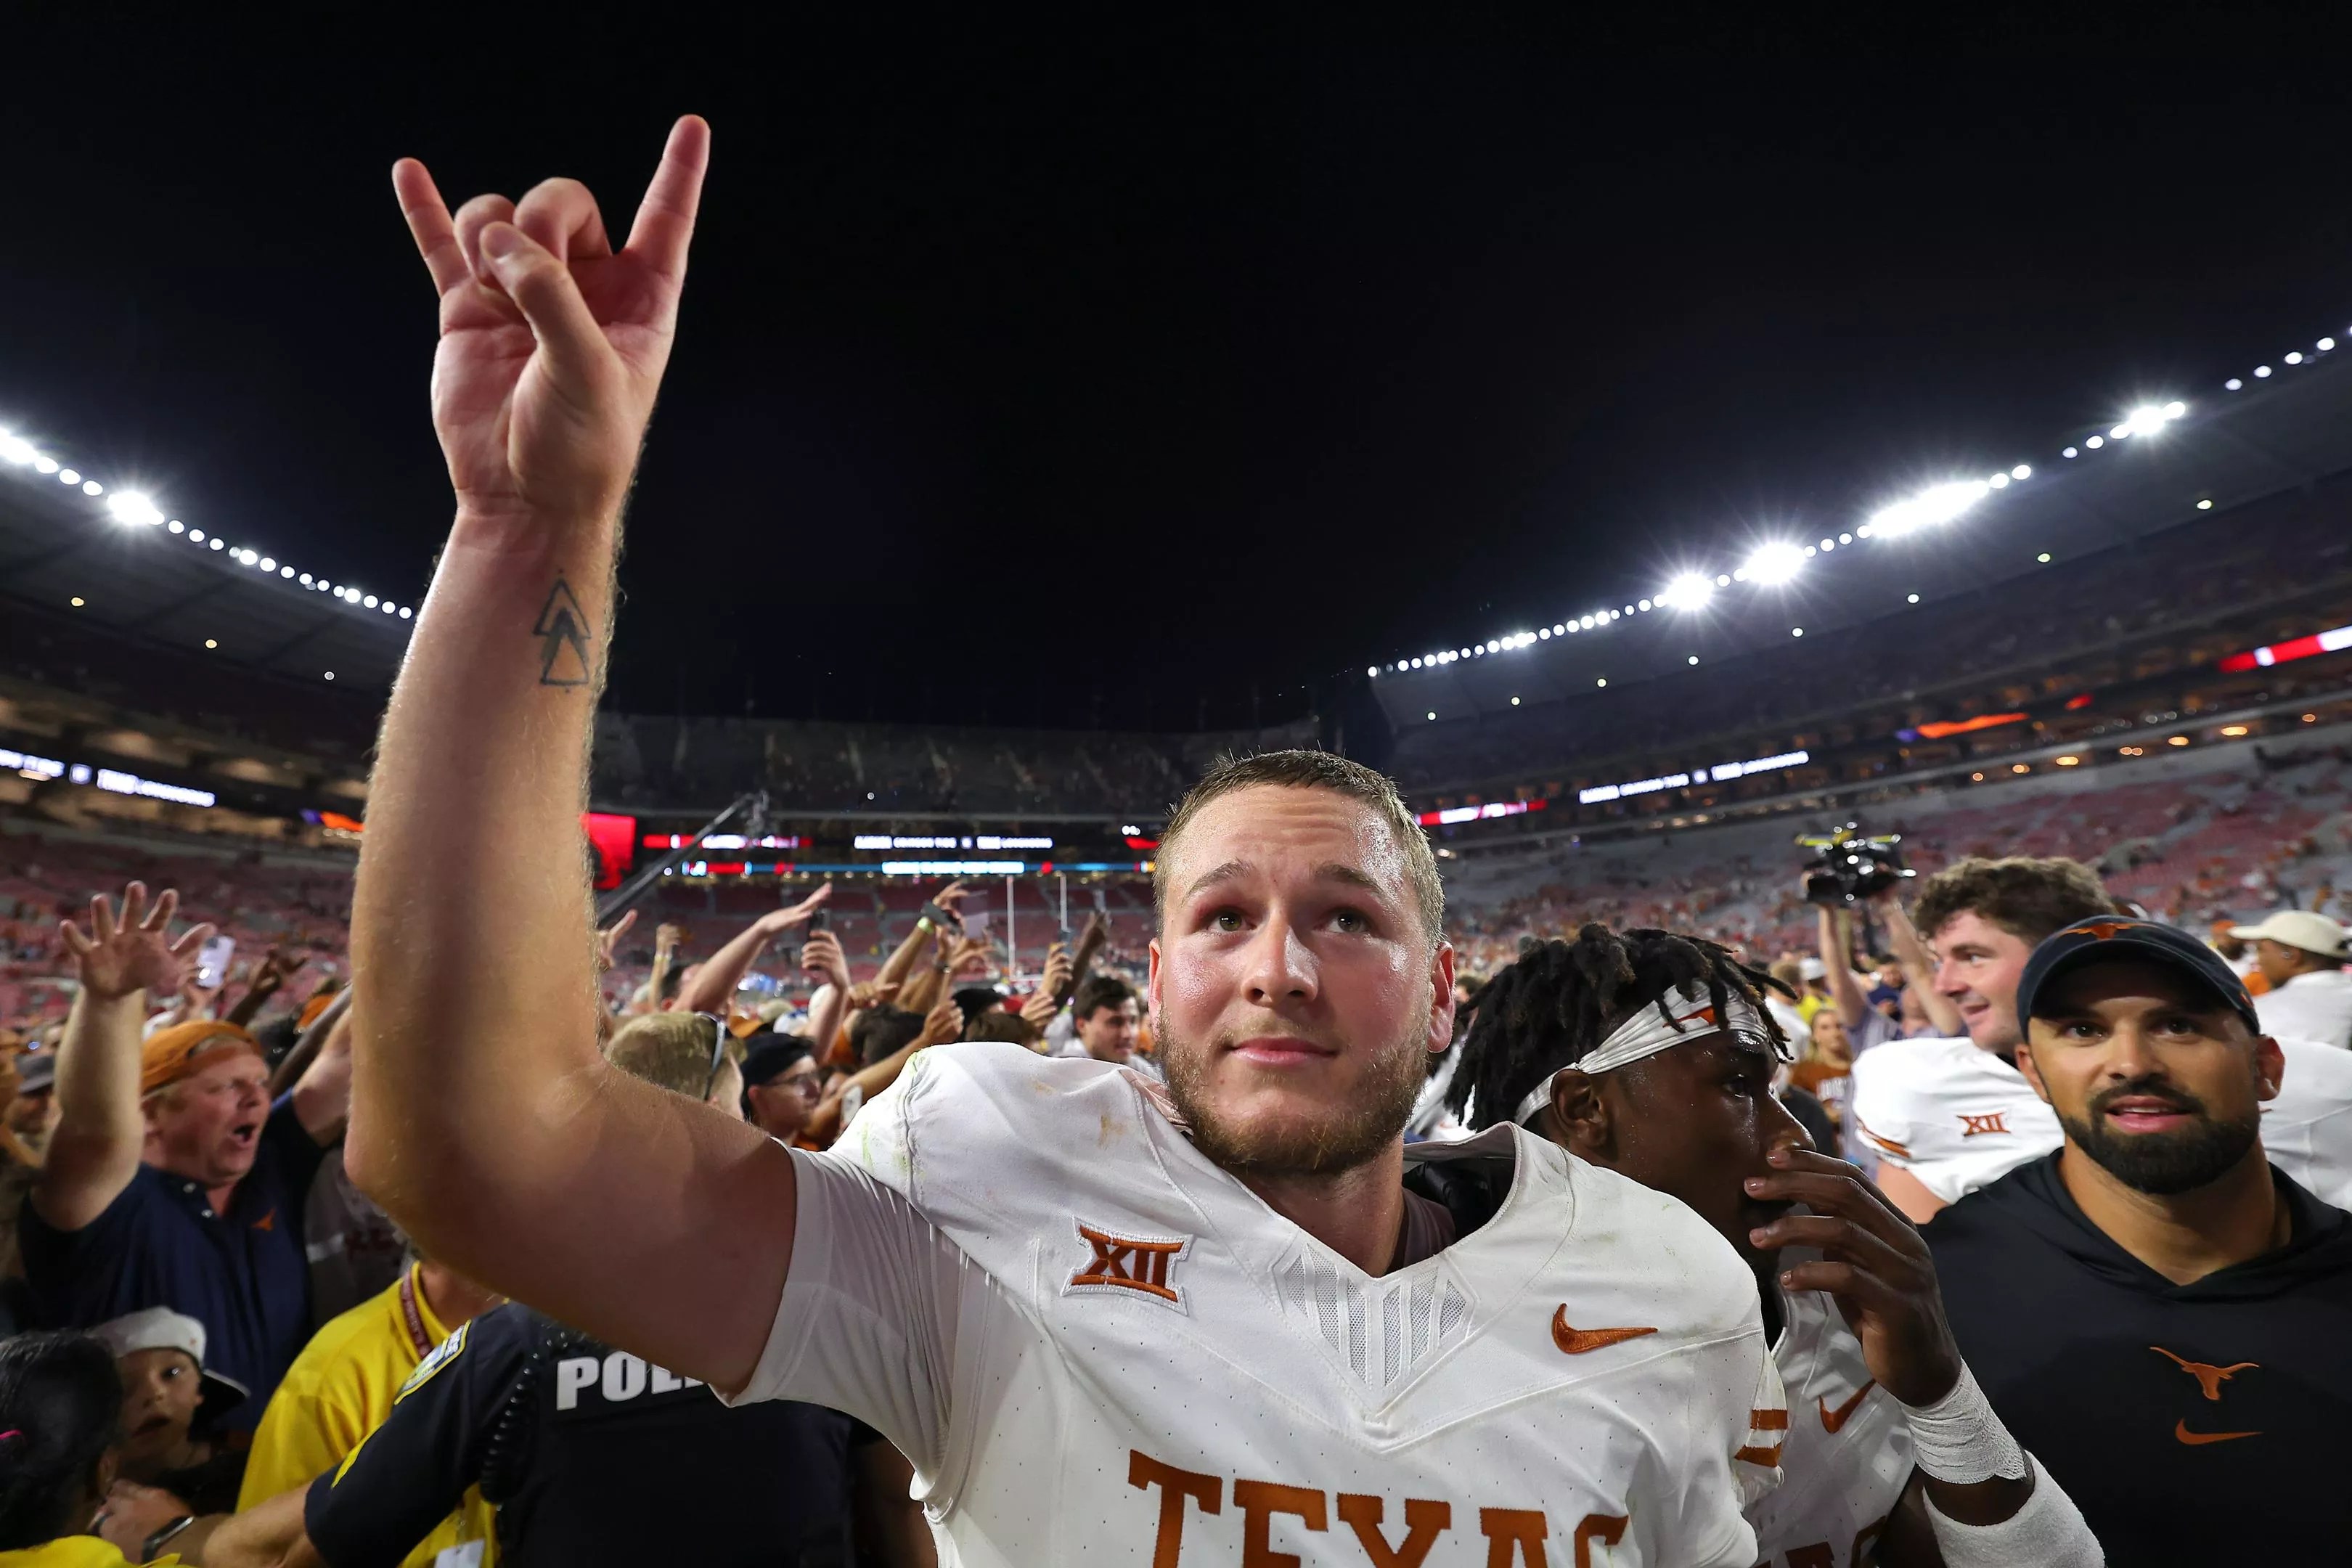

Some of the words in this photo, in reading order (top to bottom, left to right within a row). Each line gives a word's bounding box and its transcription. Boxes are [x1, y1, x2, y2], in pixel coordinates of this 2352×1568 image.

[1956, 1111, 2010, 1137] XII
[1071, 1225, 1185, 1302] XII
[556, 1350, 703, 1410] POL
